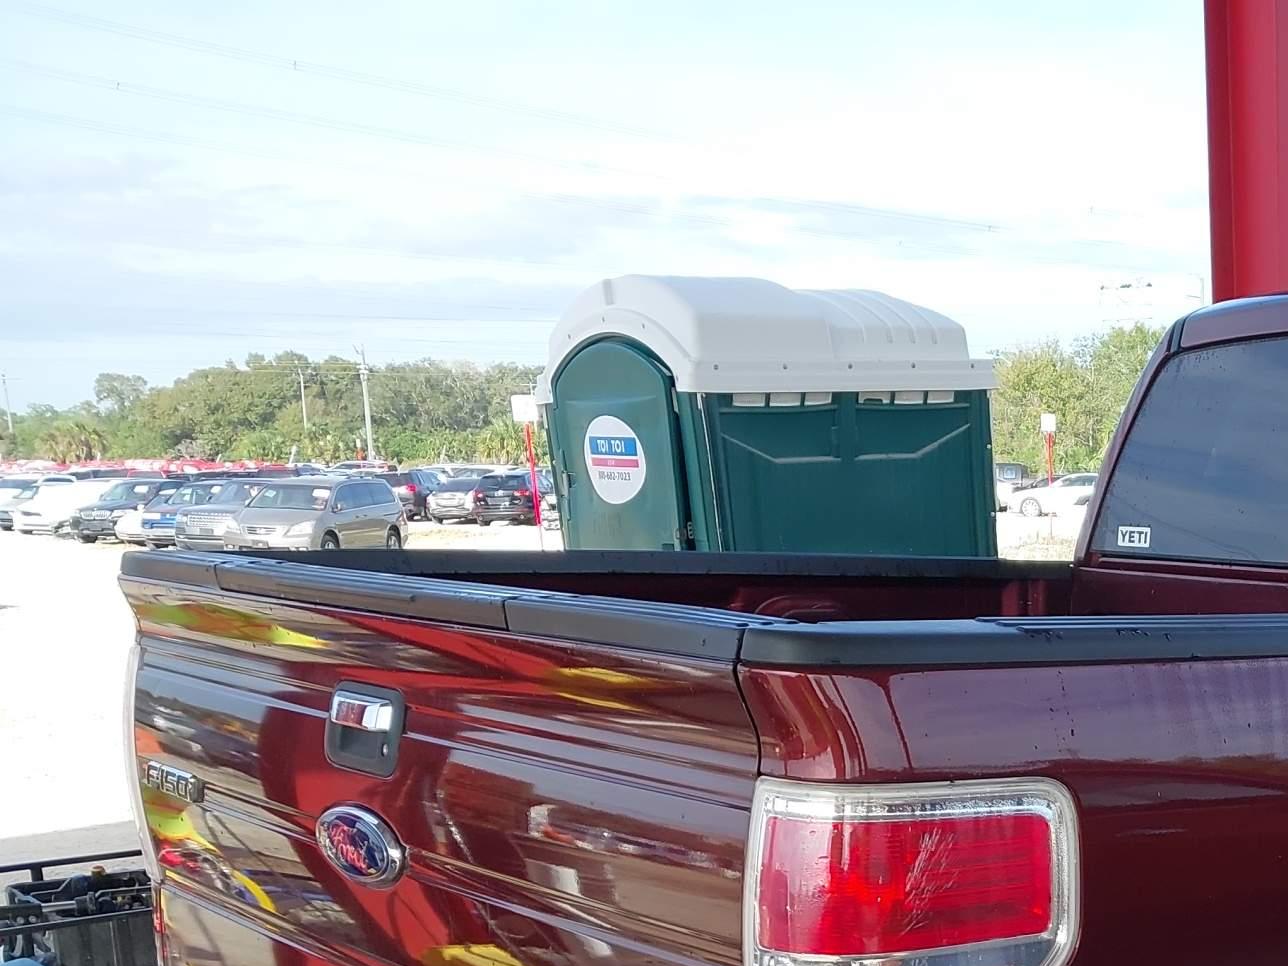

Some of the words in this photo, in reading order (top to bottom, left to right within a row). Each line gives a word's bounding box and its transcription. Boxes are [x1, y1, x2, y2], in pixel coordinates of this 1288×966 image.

[596, 439, 608, 453] TOI
[611, 439, 625, 453] TOI
[1119, 529, 1148, 545] YETI
[329, 820, 370, 875] Ford
